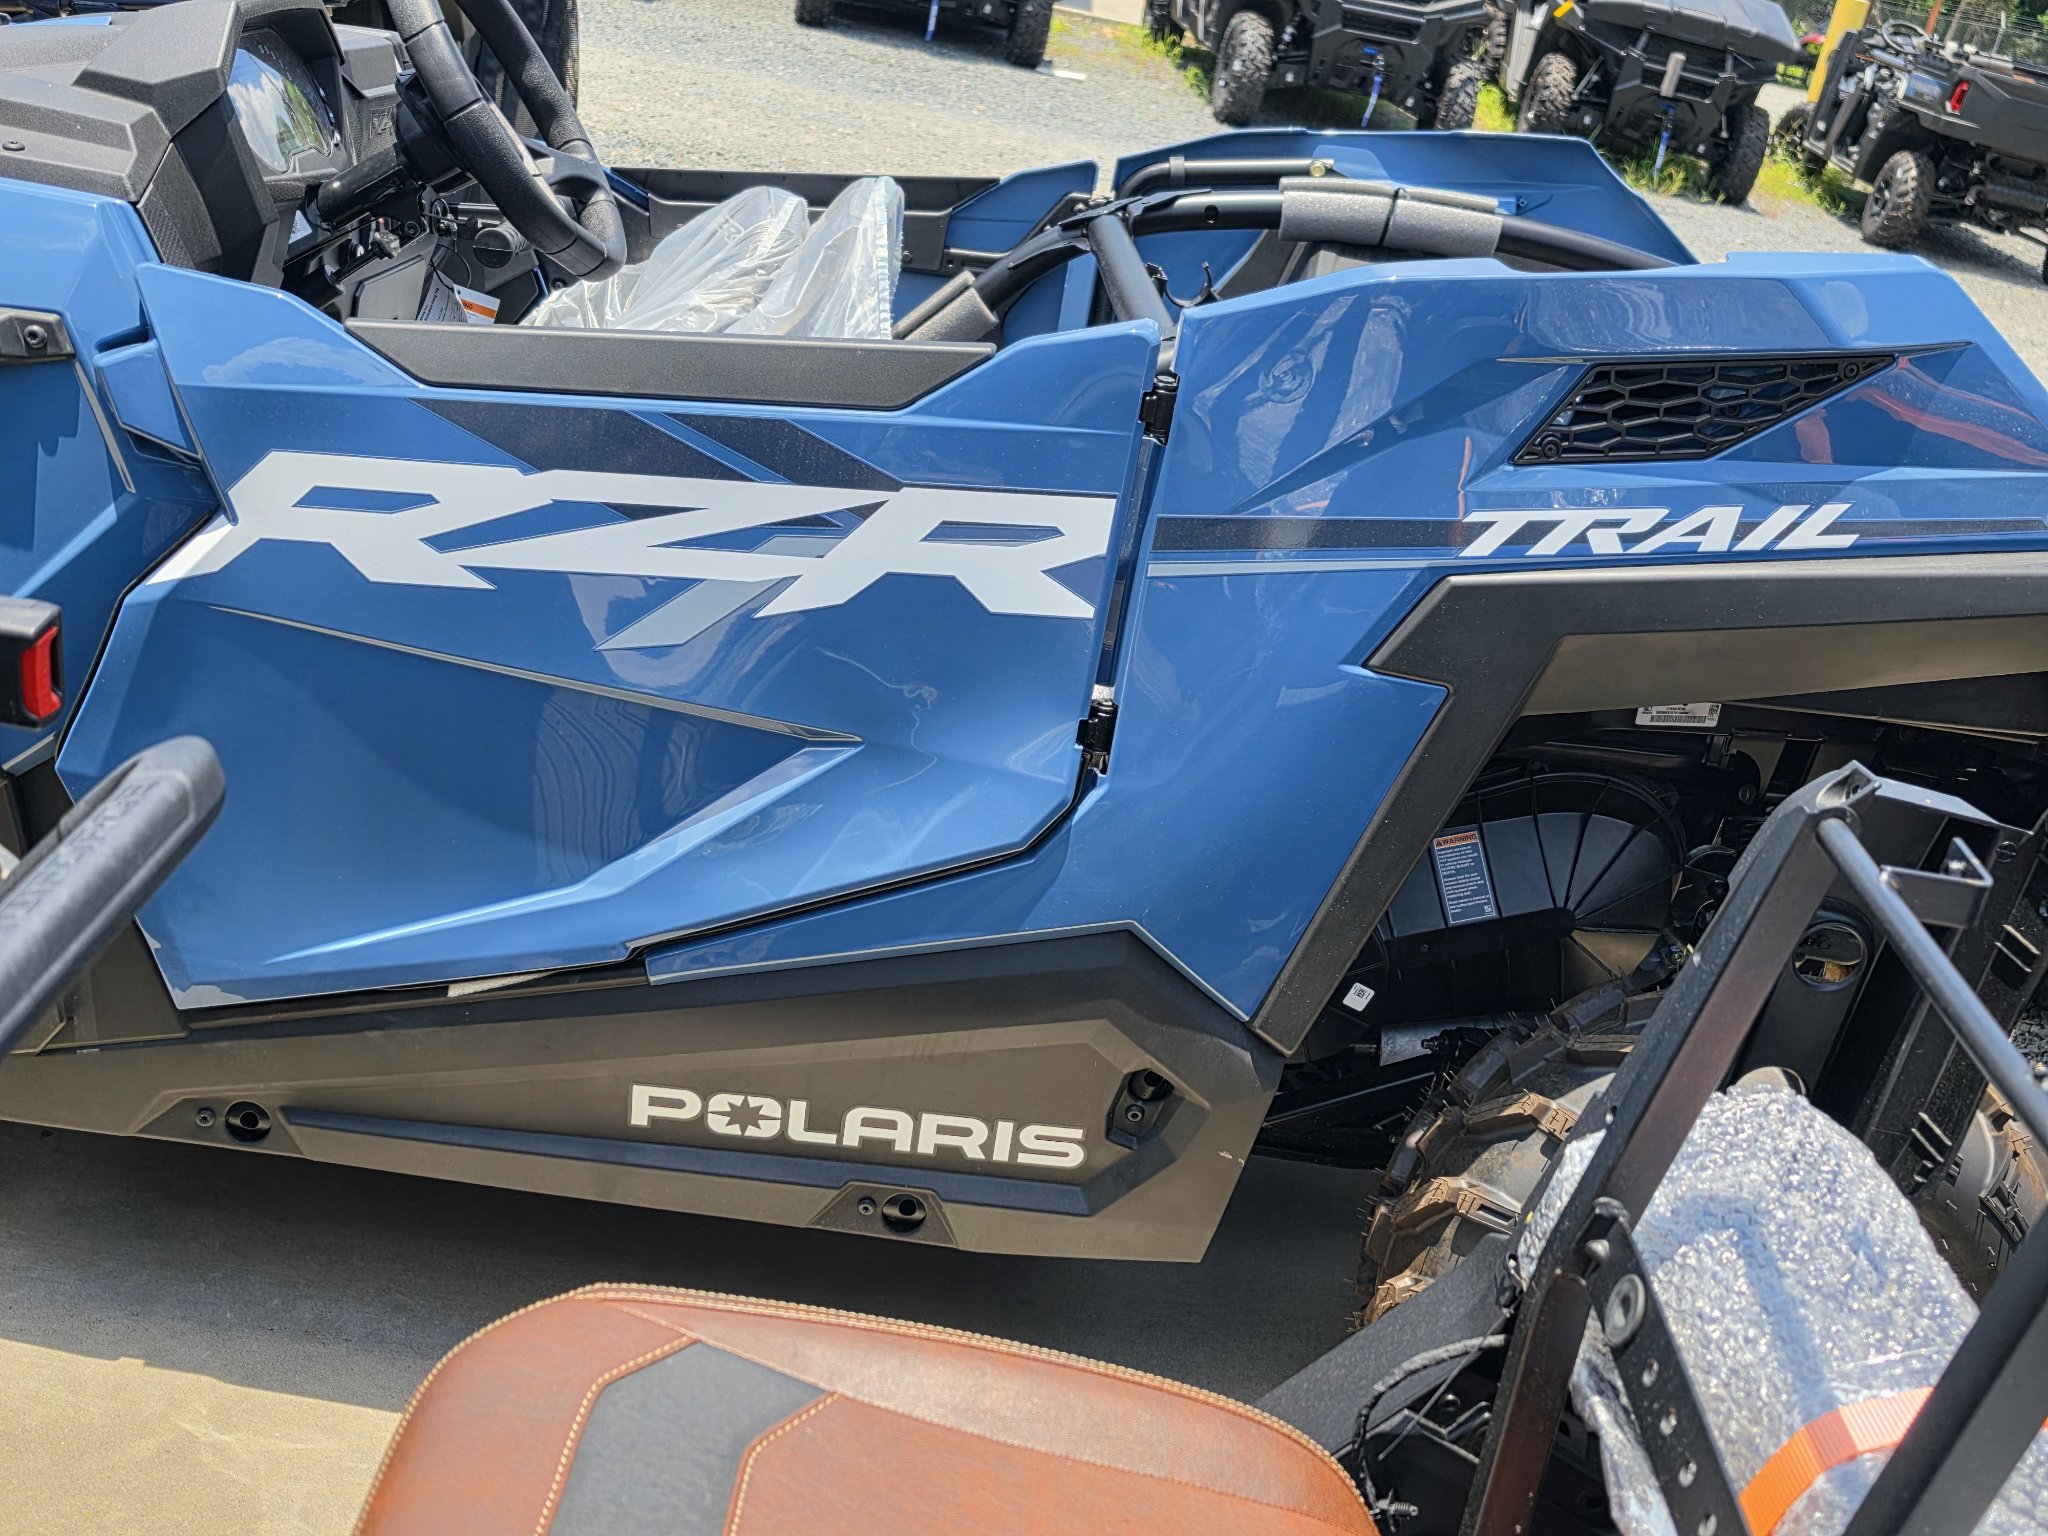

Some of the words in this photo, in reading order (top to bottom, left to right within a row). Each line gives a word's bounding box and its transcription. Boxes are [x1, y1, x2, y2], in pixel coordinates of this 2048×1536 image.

[146, 450, 1118, 650] RZR
[1458, 503, 1860, 556] TRAIL
[1442, 833, 1477, 845] WARNING
[630, 1084, 1084, 1168] POLARIS
